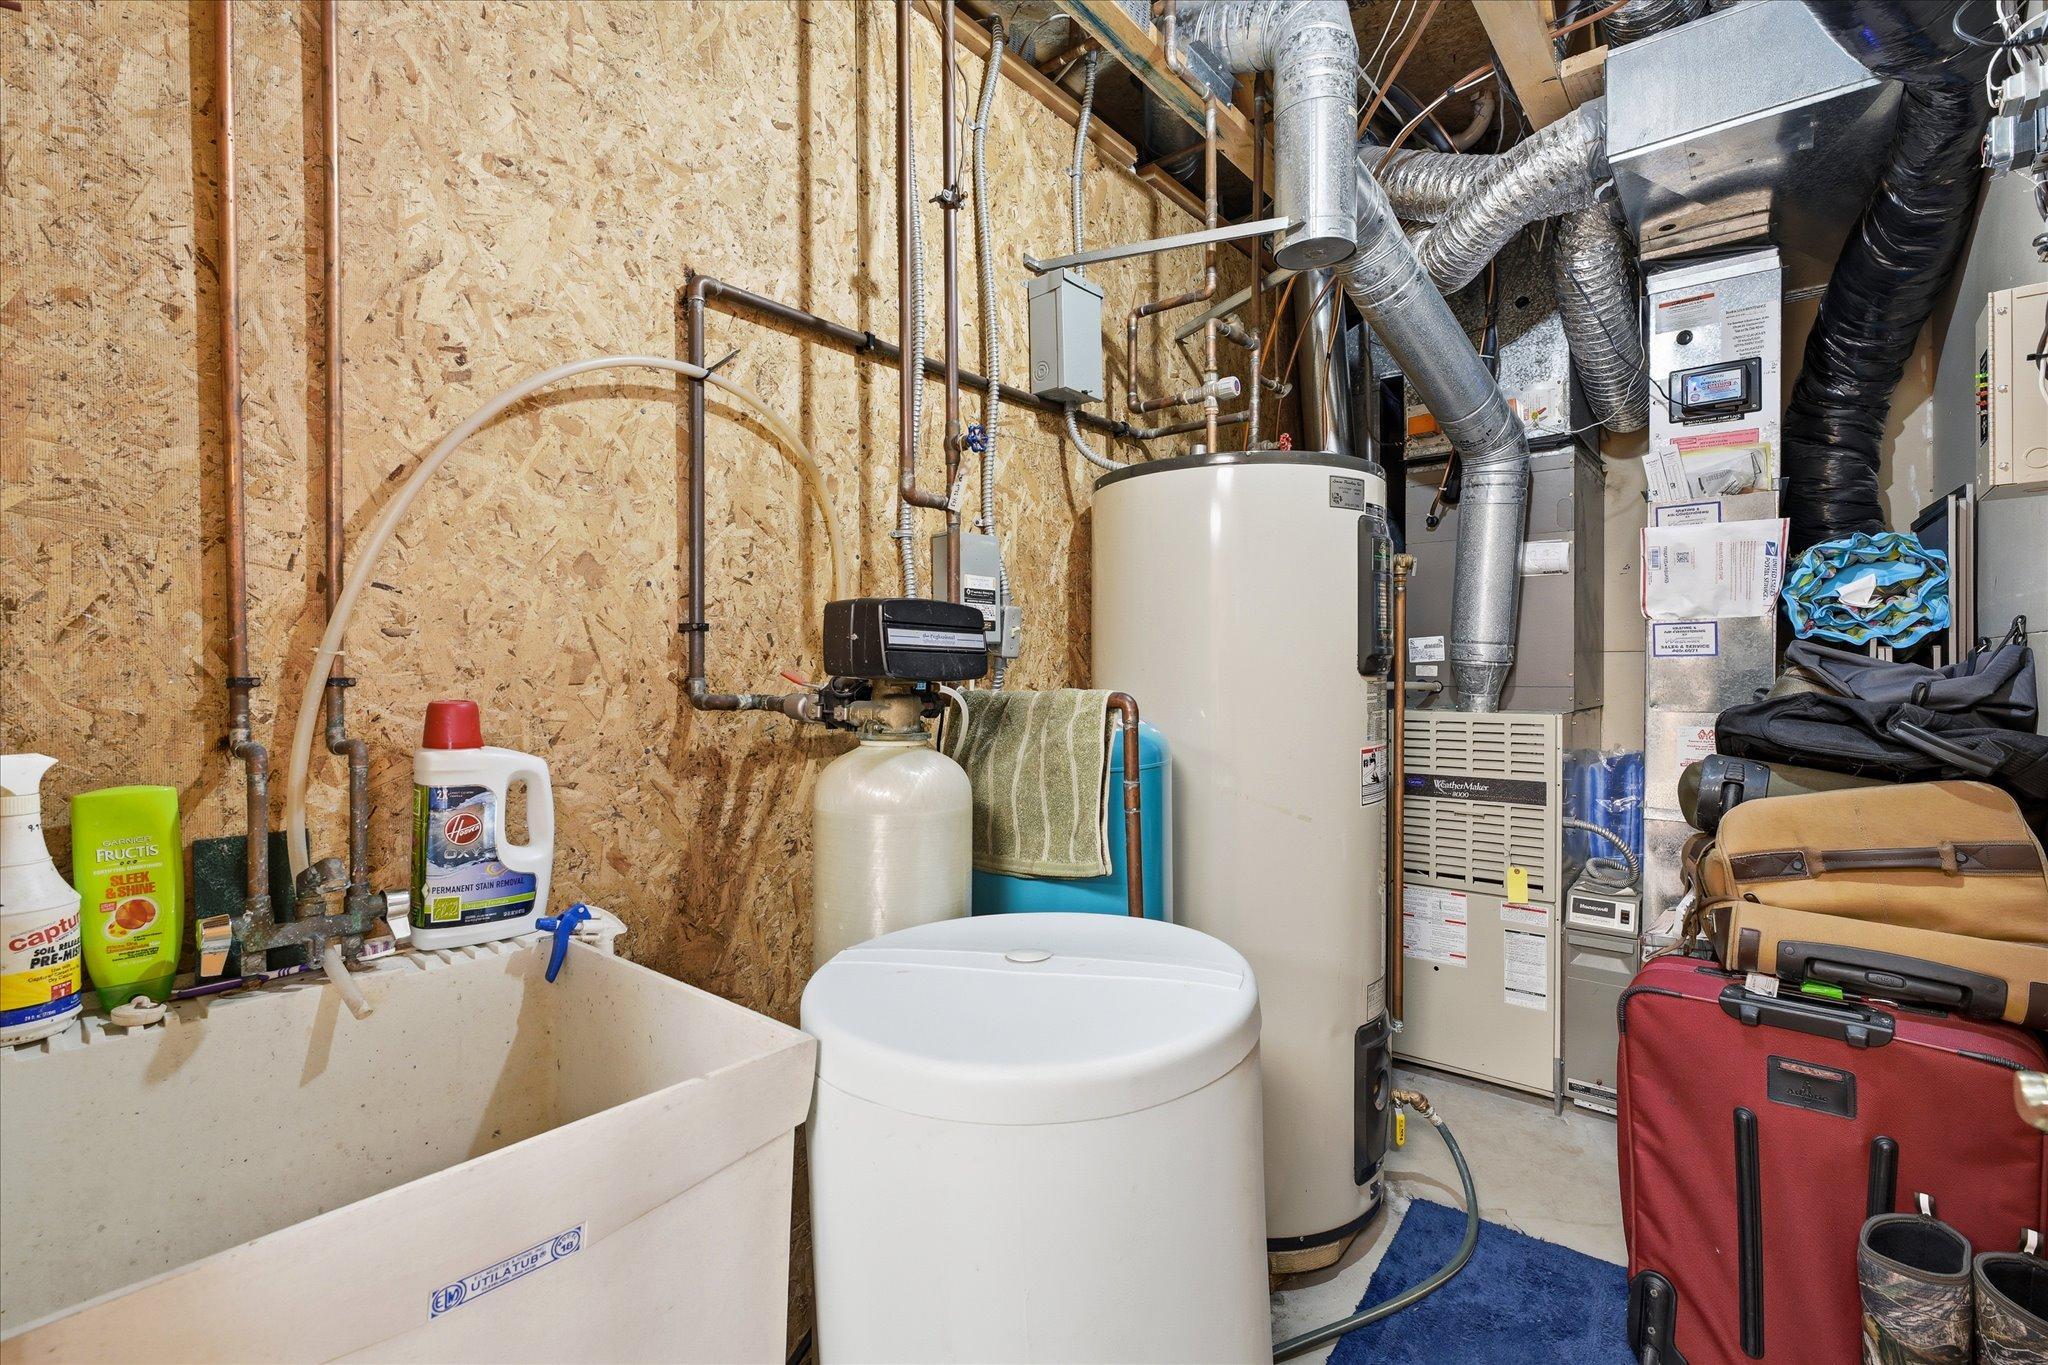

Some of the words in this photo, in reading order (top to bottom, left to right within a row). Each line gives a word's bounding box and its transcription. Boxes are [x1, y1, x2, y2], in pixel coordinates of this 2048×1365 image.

[1433, 779, 1490, 793] WeatherMaker
[437, 788, 448, 800] 2X
[103, 836, 150, 847] GARNIER
[95, 843, 159, 863] FRUCTIS
[444, 847, 482, 859] OXY
[110, 871, 149, 887] SLEEK
[431, 884, 474, 894] PERMANENT
[476, 882, 494, 891] STAIN
[496, 877, 525, 888] REMOVAL
[106, 887, 116, 899] &
[118, 882, 156, 898] SHINE
[34, 946, 56, 957] SOIL
[560, 1241, 574, 1252] 18
[470, 1252, 539, 1292] UTILATUB
